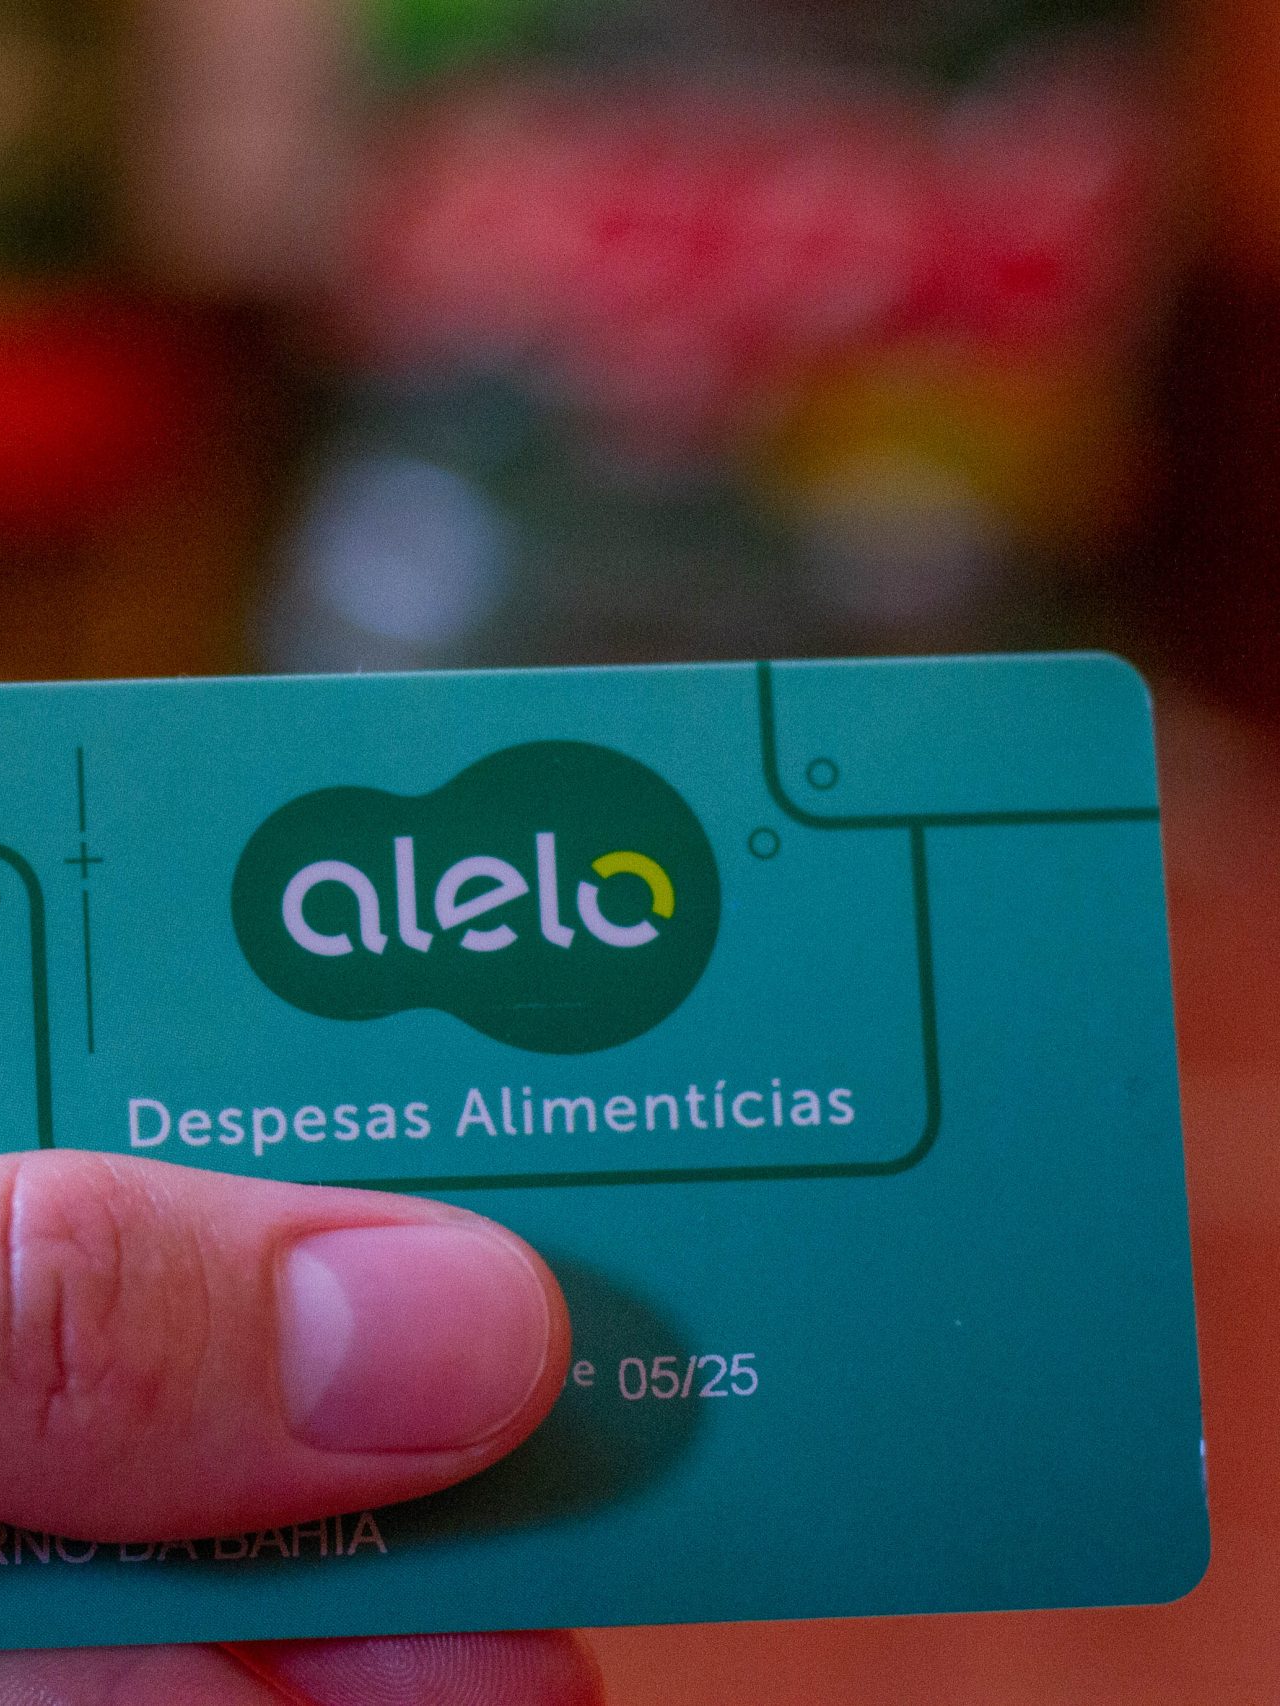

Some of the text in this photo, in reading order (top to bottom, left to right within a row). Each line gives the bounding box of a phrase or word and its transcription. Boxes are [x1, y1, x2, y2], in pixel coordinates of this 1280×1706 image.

[281, 832, 675, 957] alelo
[128, 1078, 856, 1156] Despesas Alimentícias
[619, 1352, 759, 1400] 05/25
[213, 1511, 388, 1560] BAHIA
